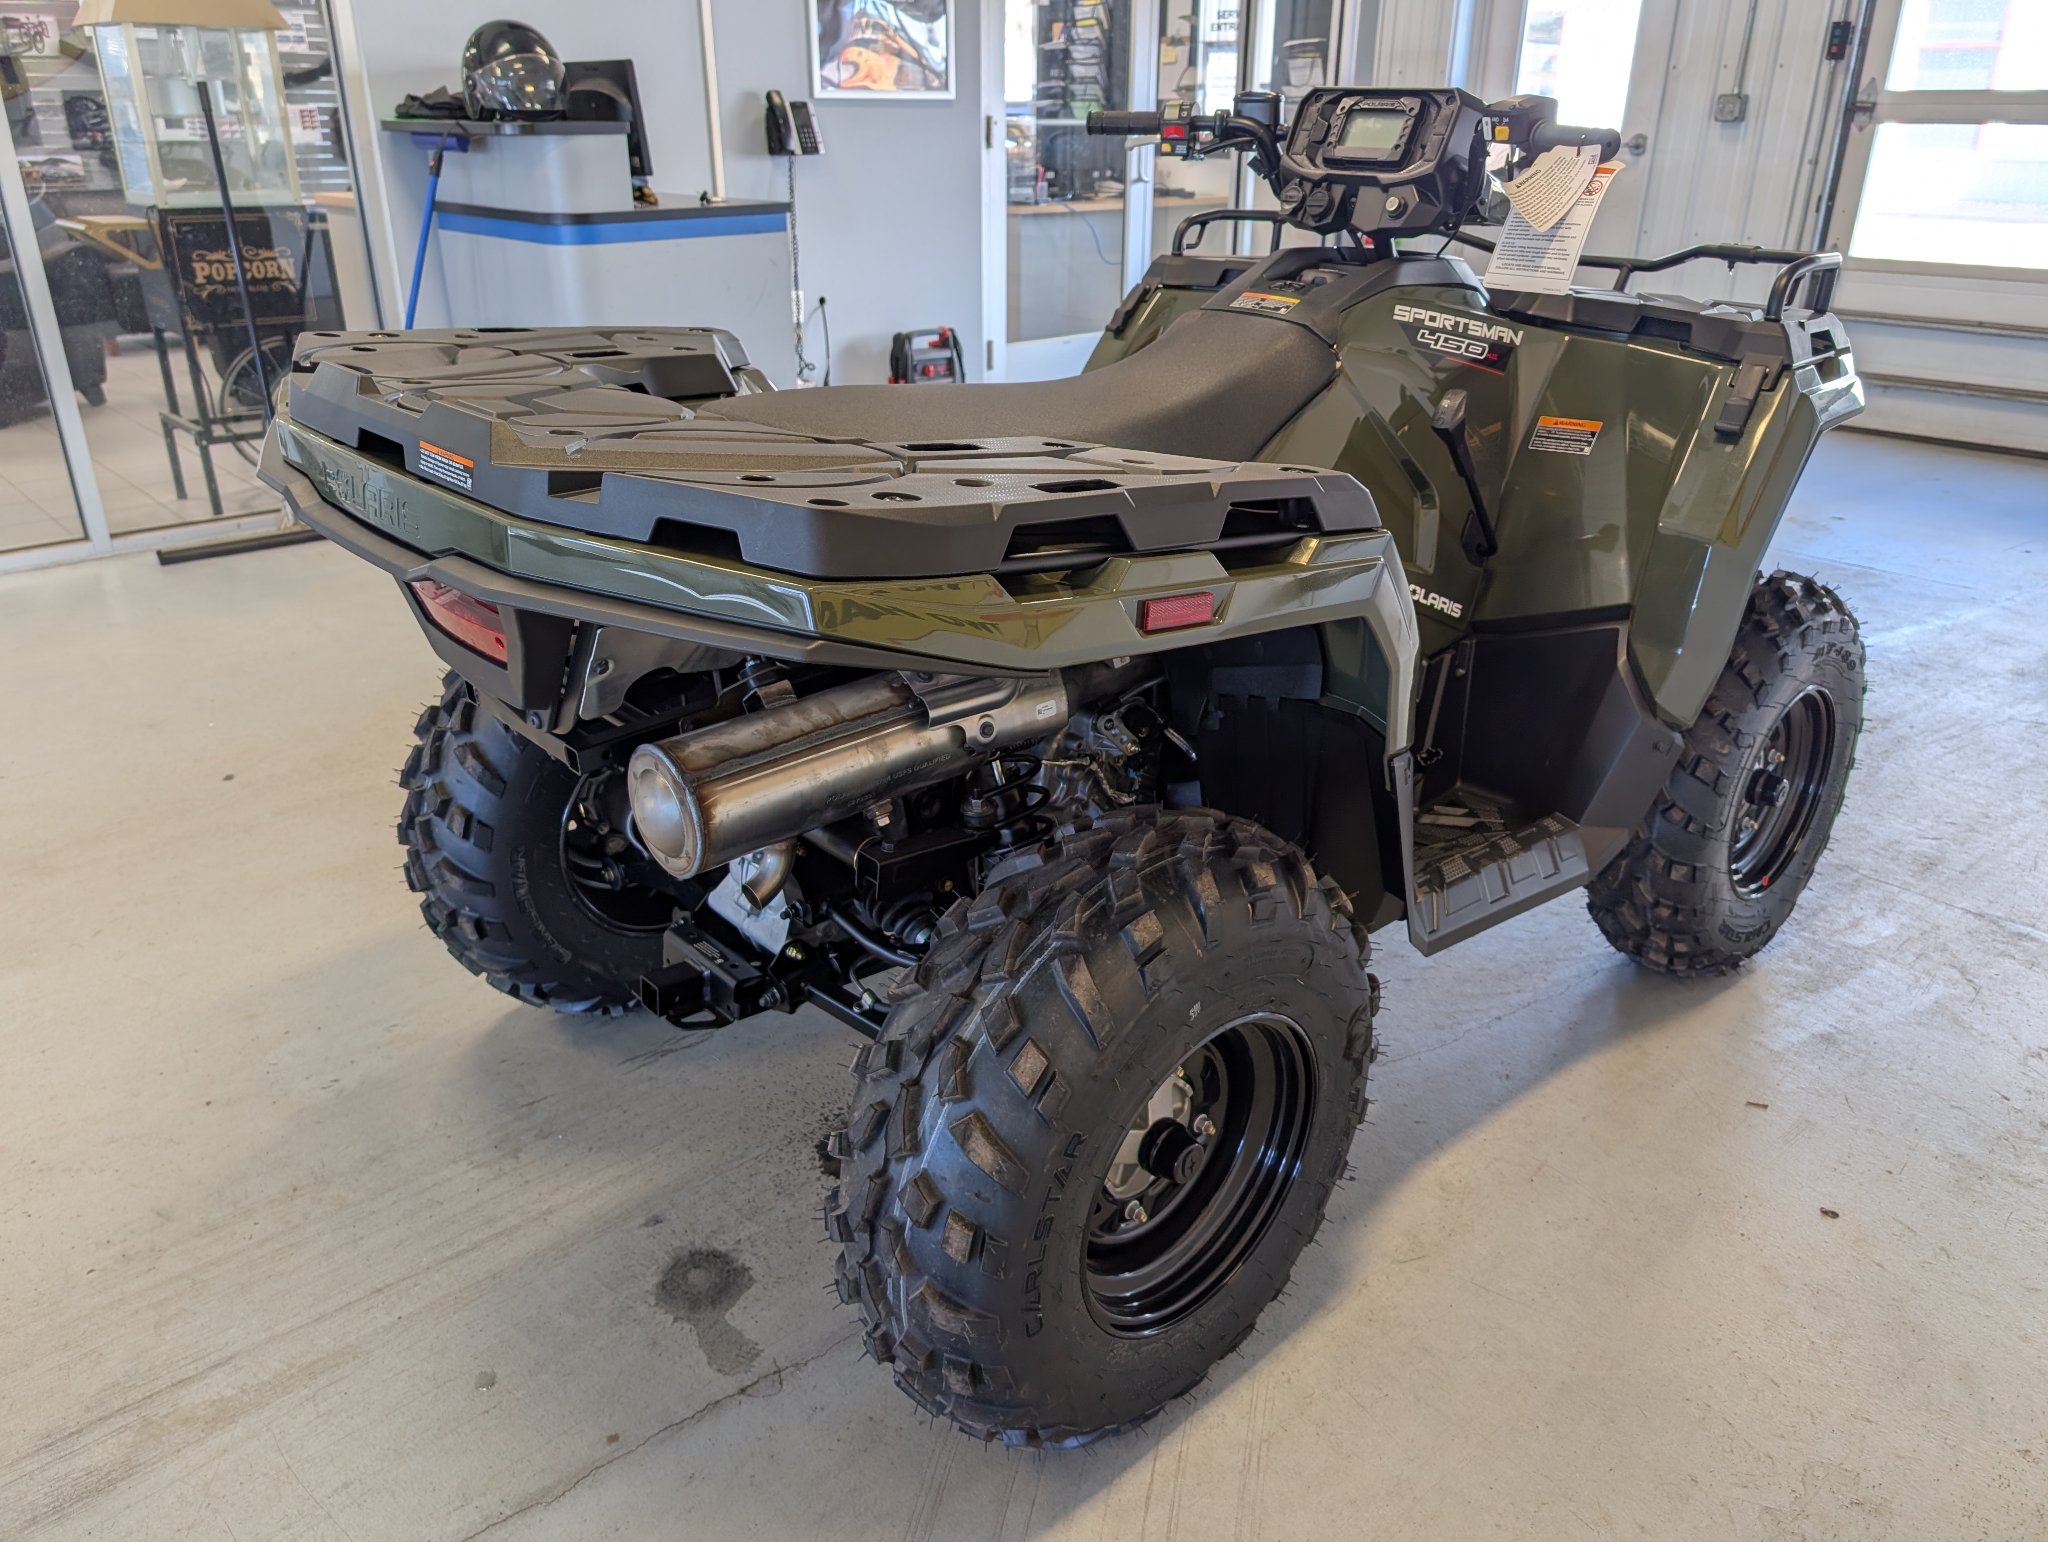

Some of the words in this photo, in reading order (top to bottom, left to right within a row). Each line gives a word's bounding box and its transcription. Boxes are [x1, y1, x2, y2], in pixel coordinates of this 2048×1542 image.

[1519, 169, 1541, 187] WARNING
[1393, 304, 1524, 346] SPORTSMAN
[1417, 329, 1489, 360] 450
[1408, 583, 1463, 618] OLARIS
[1022, 1131, 1088, 1338] CARLSTAR
